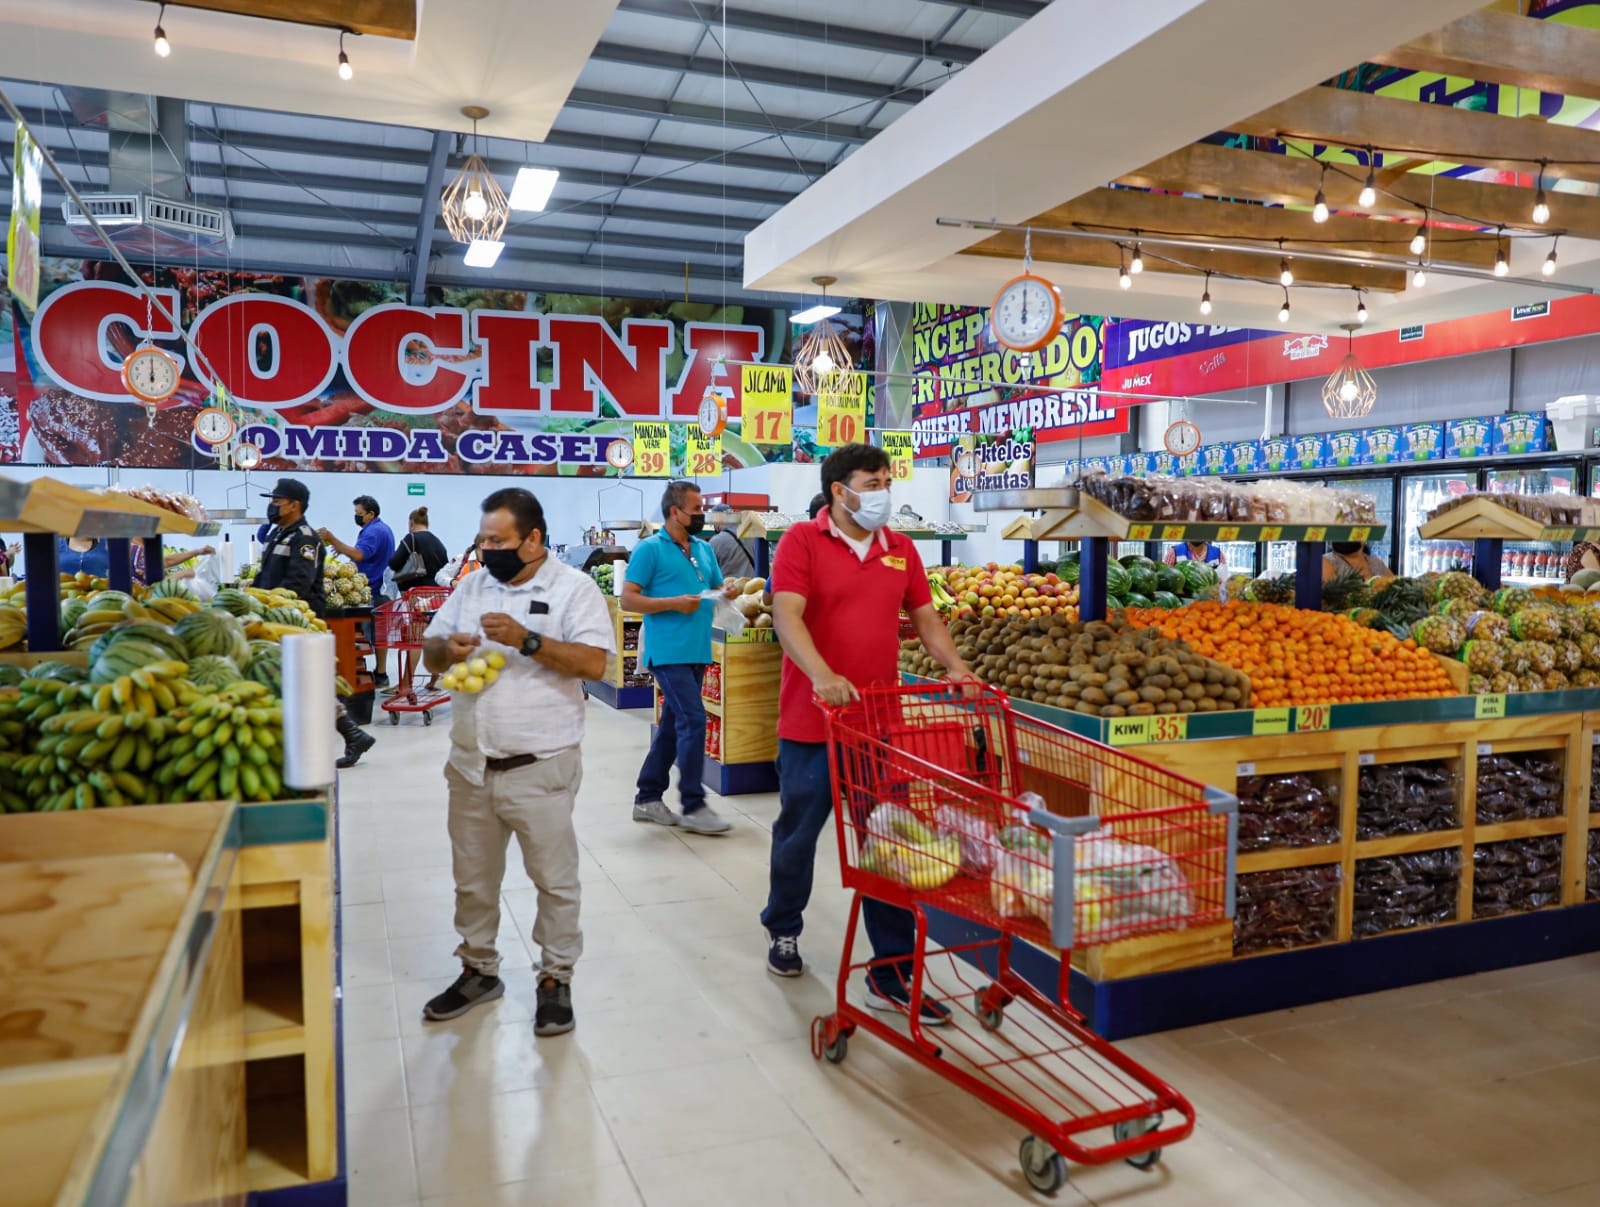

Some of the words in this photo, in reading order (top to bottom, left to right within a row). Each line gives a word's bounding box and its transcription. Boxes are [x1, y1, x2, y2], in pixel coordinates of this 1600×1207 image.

[33, 281, 764, 421] COCINA
[1128, 320, 1192, 361] JUGOS
[744, 370, 787, 393] JICAMA
[1121, 373, 1152, 390] JUMEX
[634, 424, 667, 439] MANZANA
[754, 410, 783, 440] 17
[828, 414, 855, 443] 10
[882, 435, 911, 448] MANZANA
[641, 452, 664, 473] 39
[693, 454, 716, 474] 28
[1114, 724, 1144, 735] KIWI
[1155, 715, 1179, 741] 35
[1302, 707, 1323, 730] 20
